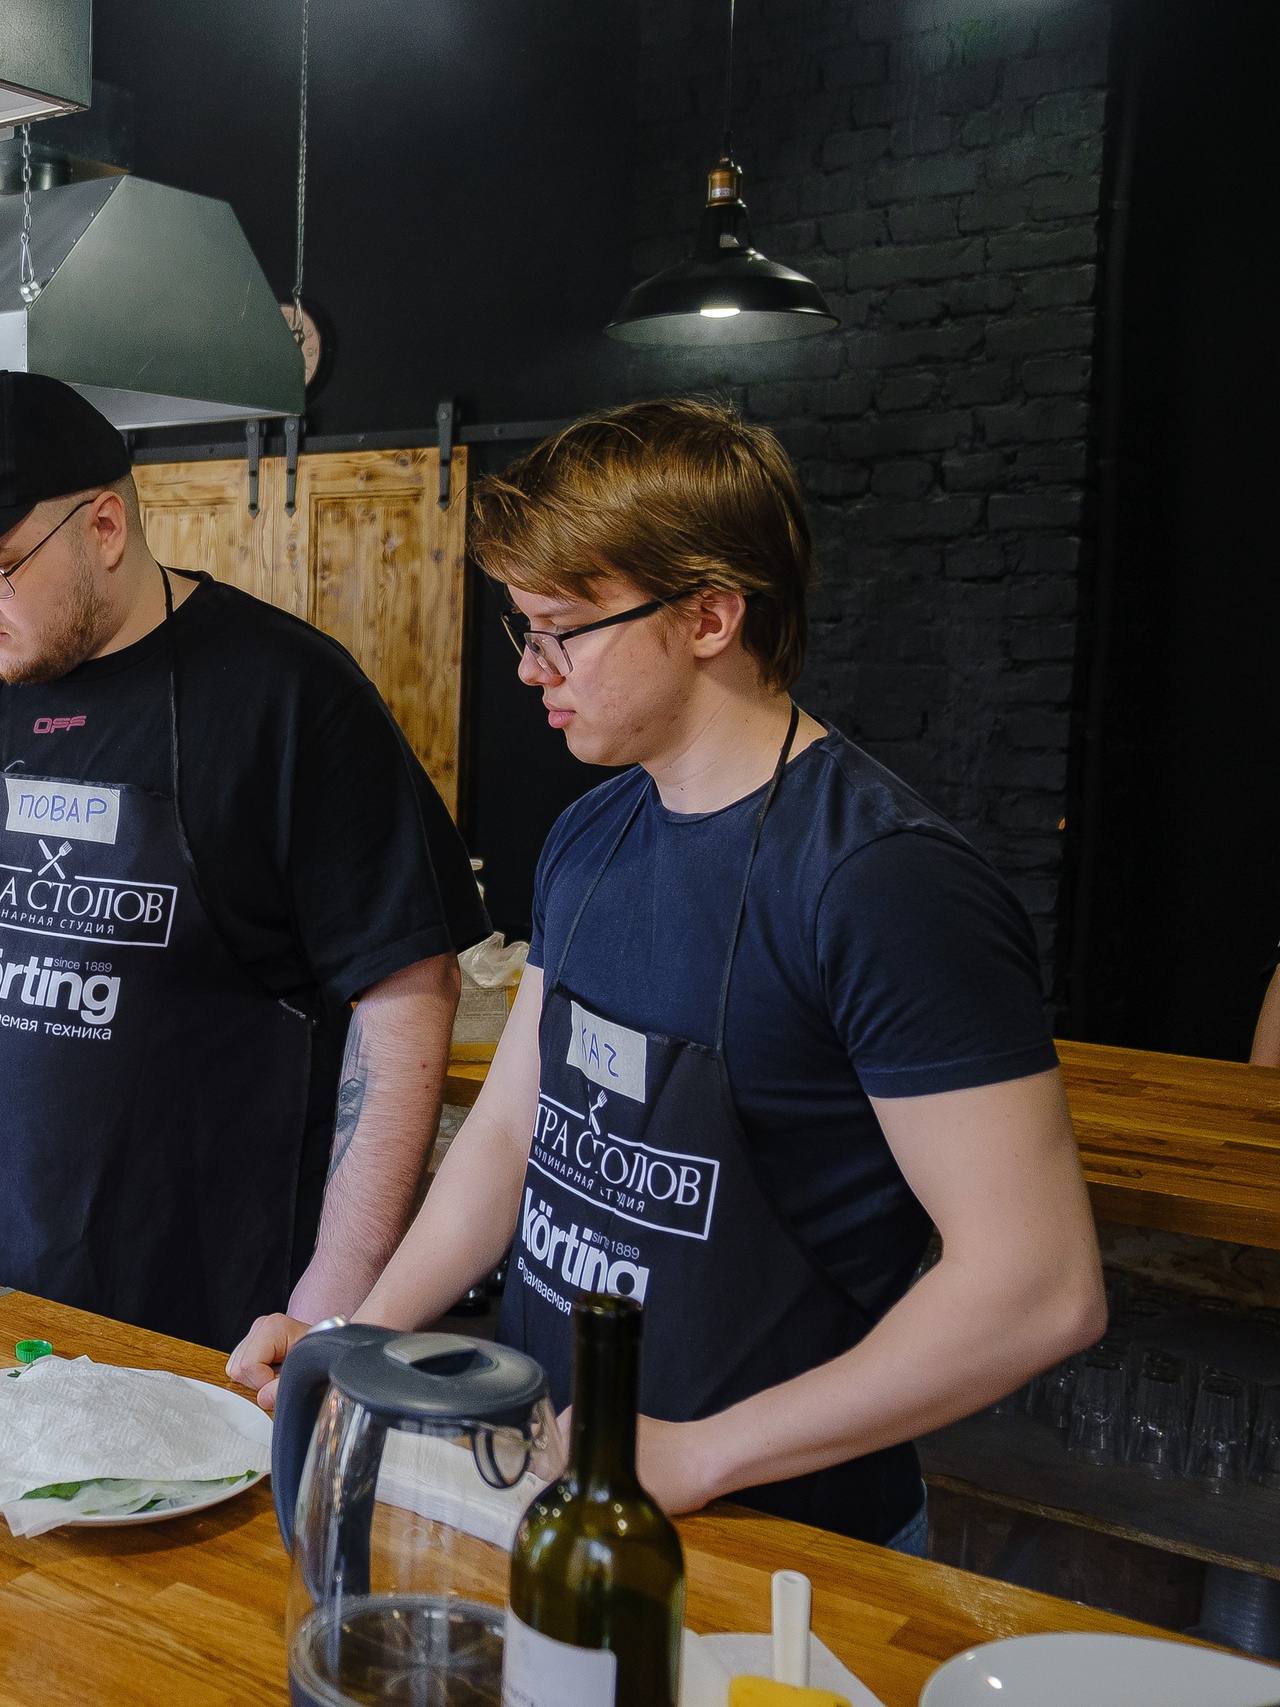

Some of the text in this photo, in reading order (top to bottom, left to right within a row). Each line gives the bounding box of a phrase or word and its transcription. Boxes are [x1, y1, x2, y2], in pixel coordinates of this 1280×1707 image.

[34, 715, 87, 734] OFF
[18, 794, 108, 824] ПОВАР
[27, 880, 164, 924] СТОЛОВ
[59, 918, 115, 935] СТУДИЯ
[53, 957, 113, 973] since 1889
[43, 1021, 113, 1041] техника
[533, 1102, 568, 1158] ГРА
[611, 1240, 640, 1260] 1889
